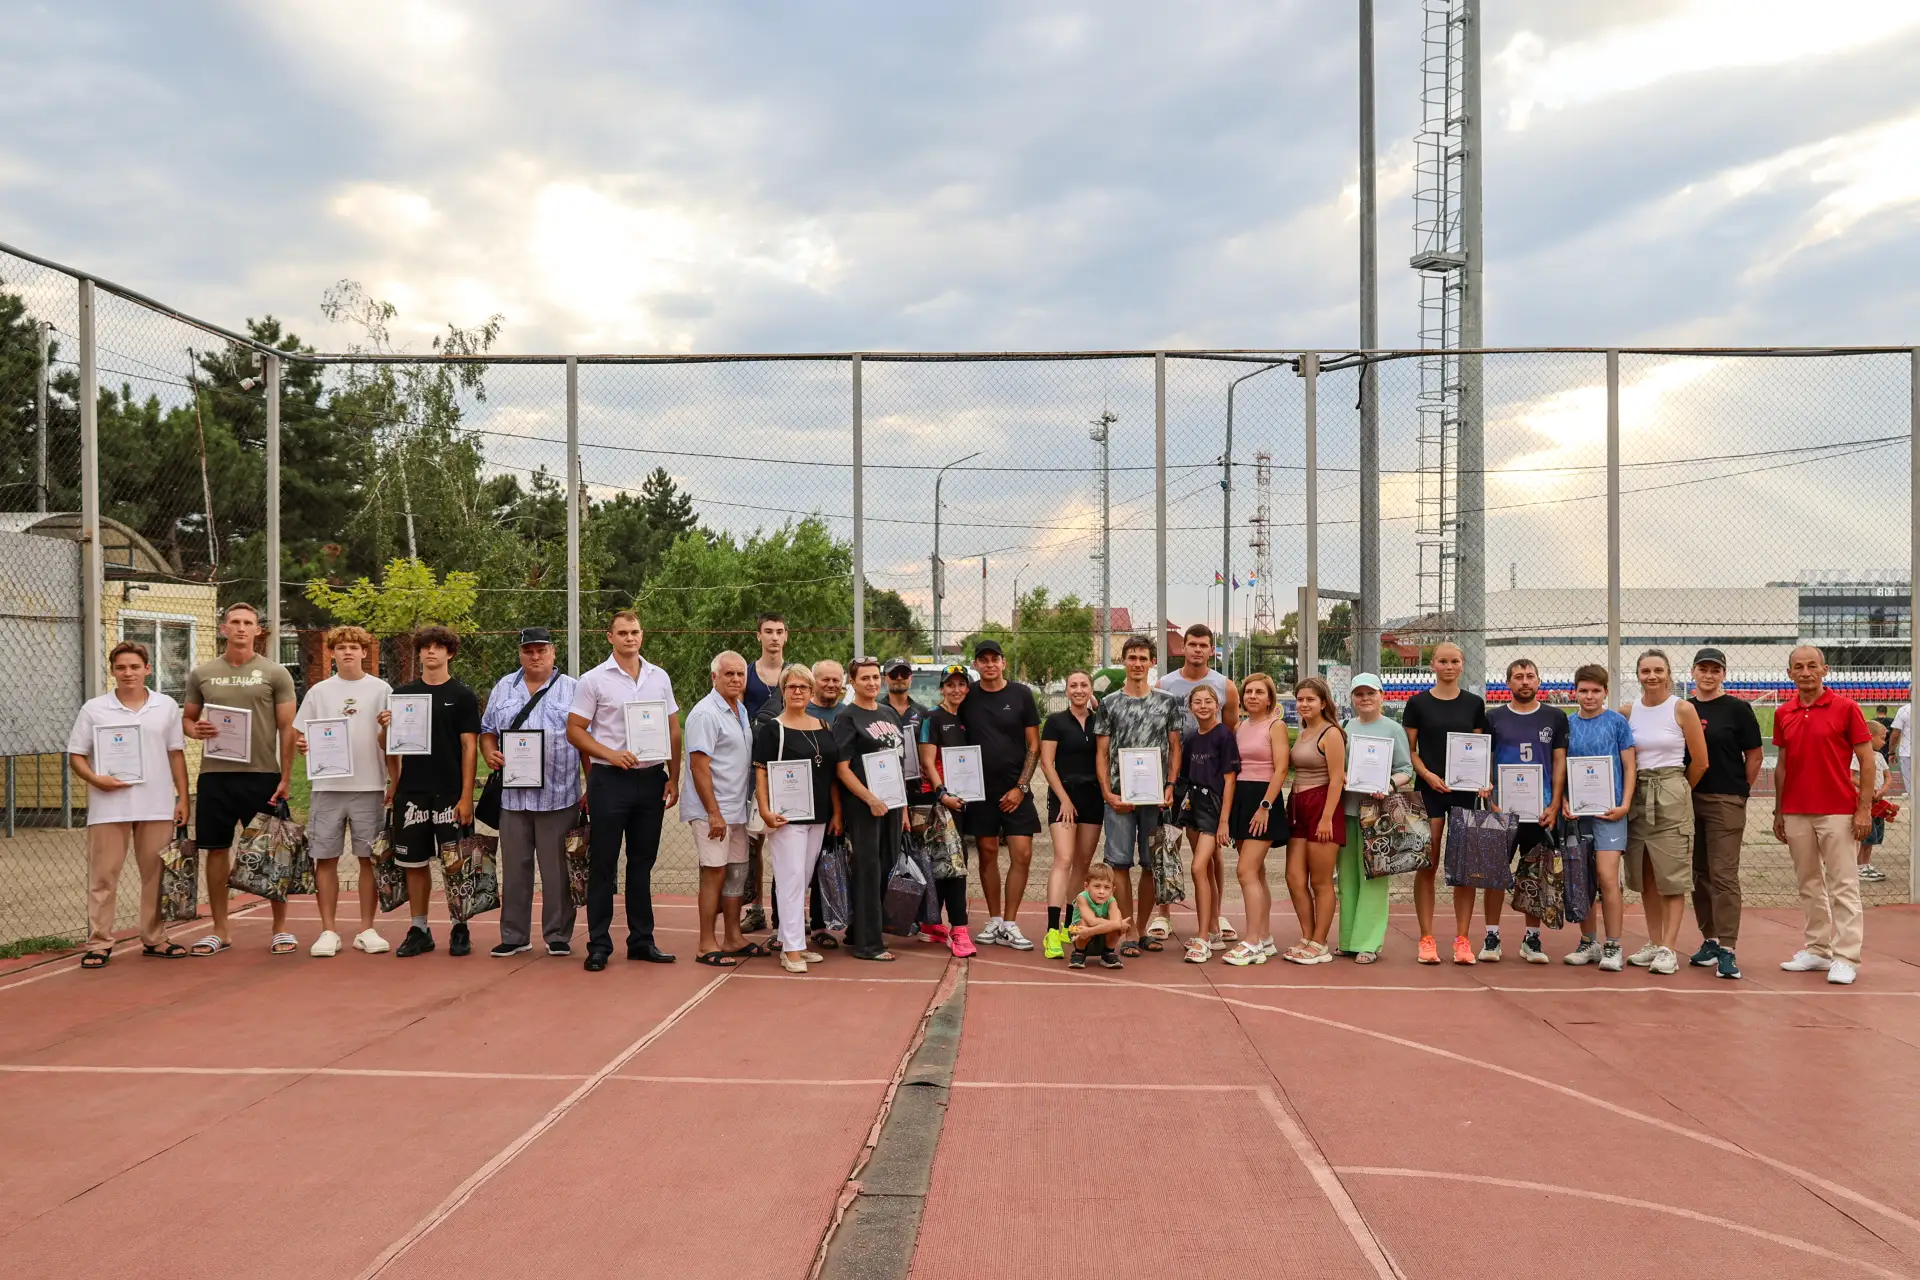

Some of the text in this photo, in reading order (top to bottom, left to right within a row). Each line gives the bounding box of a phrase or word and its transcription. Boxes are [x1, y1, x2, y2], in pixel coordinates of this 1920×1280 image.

[210, 676, 230, 685] TOM
[231, 675, 263, 686] TAILOR
[1519, 742, 1533, 762] 5
